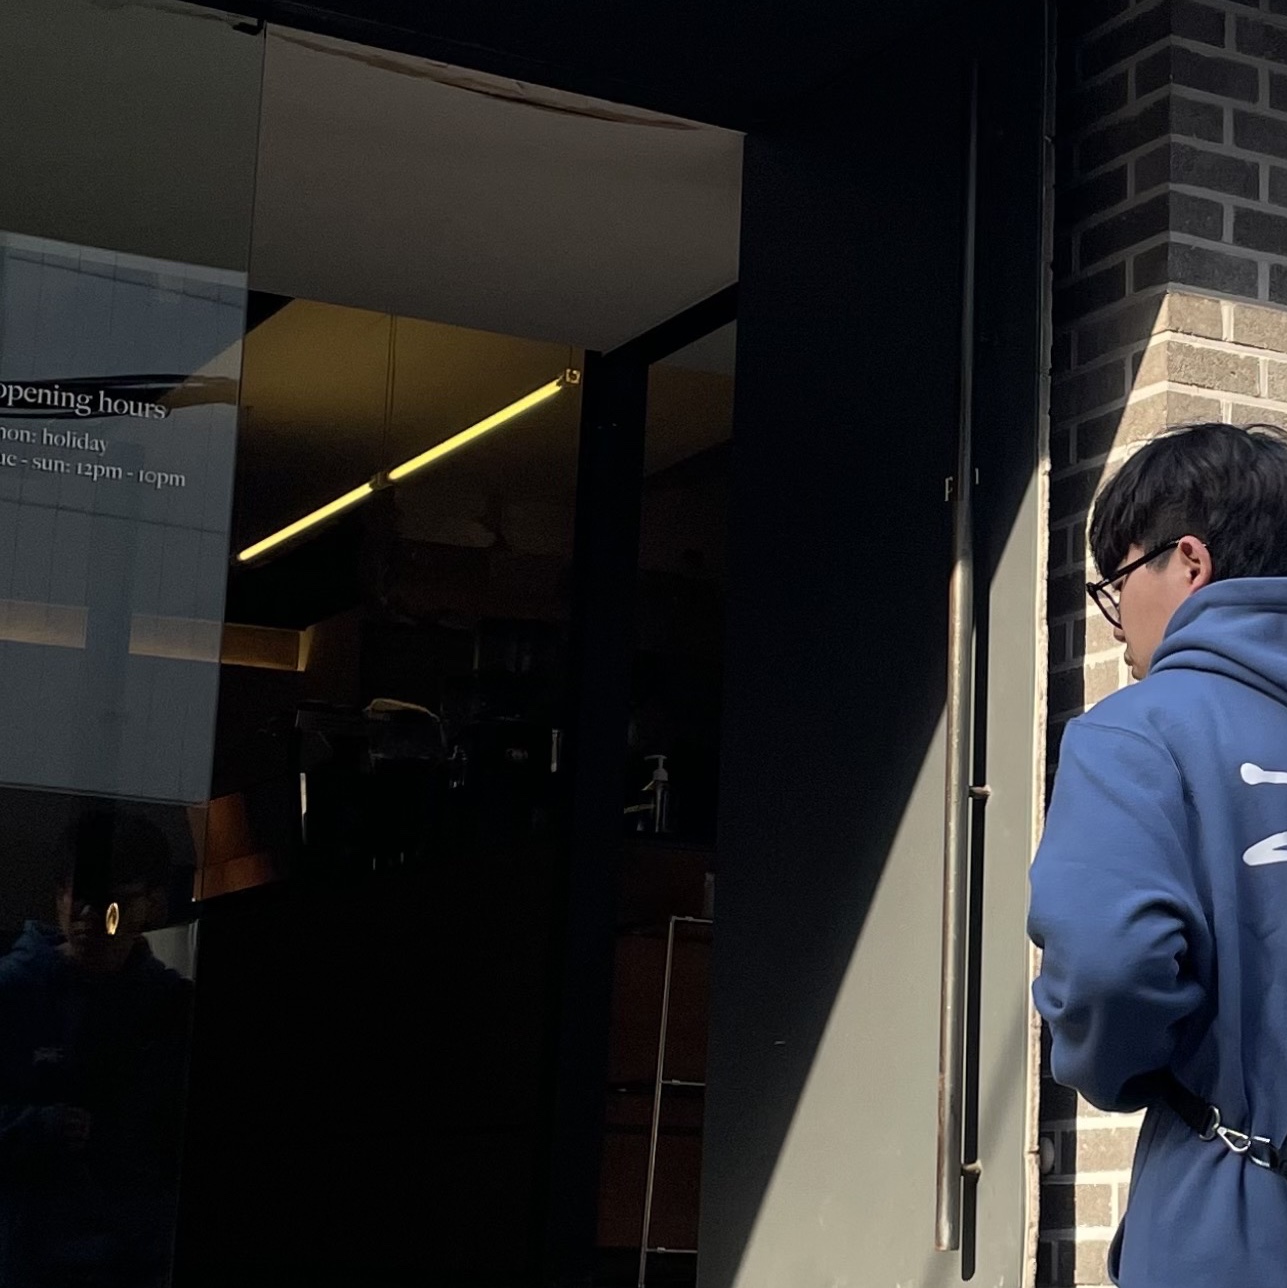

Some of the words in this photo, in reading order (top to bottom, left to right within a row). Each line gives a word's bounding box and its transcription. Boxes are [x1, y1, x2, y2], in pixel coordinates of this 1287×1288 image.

[98, 390, 167, 419] hours
[42, 428, 108, 456] holiday
[32, 456, 71, 473] sun:
[76, 461, 123, 482] 12pm
[139, 469, 186, 489] 10pm
